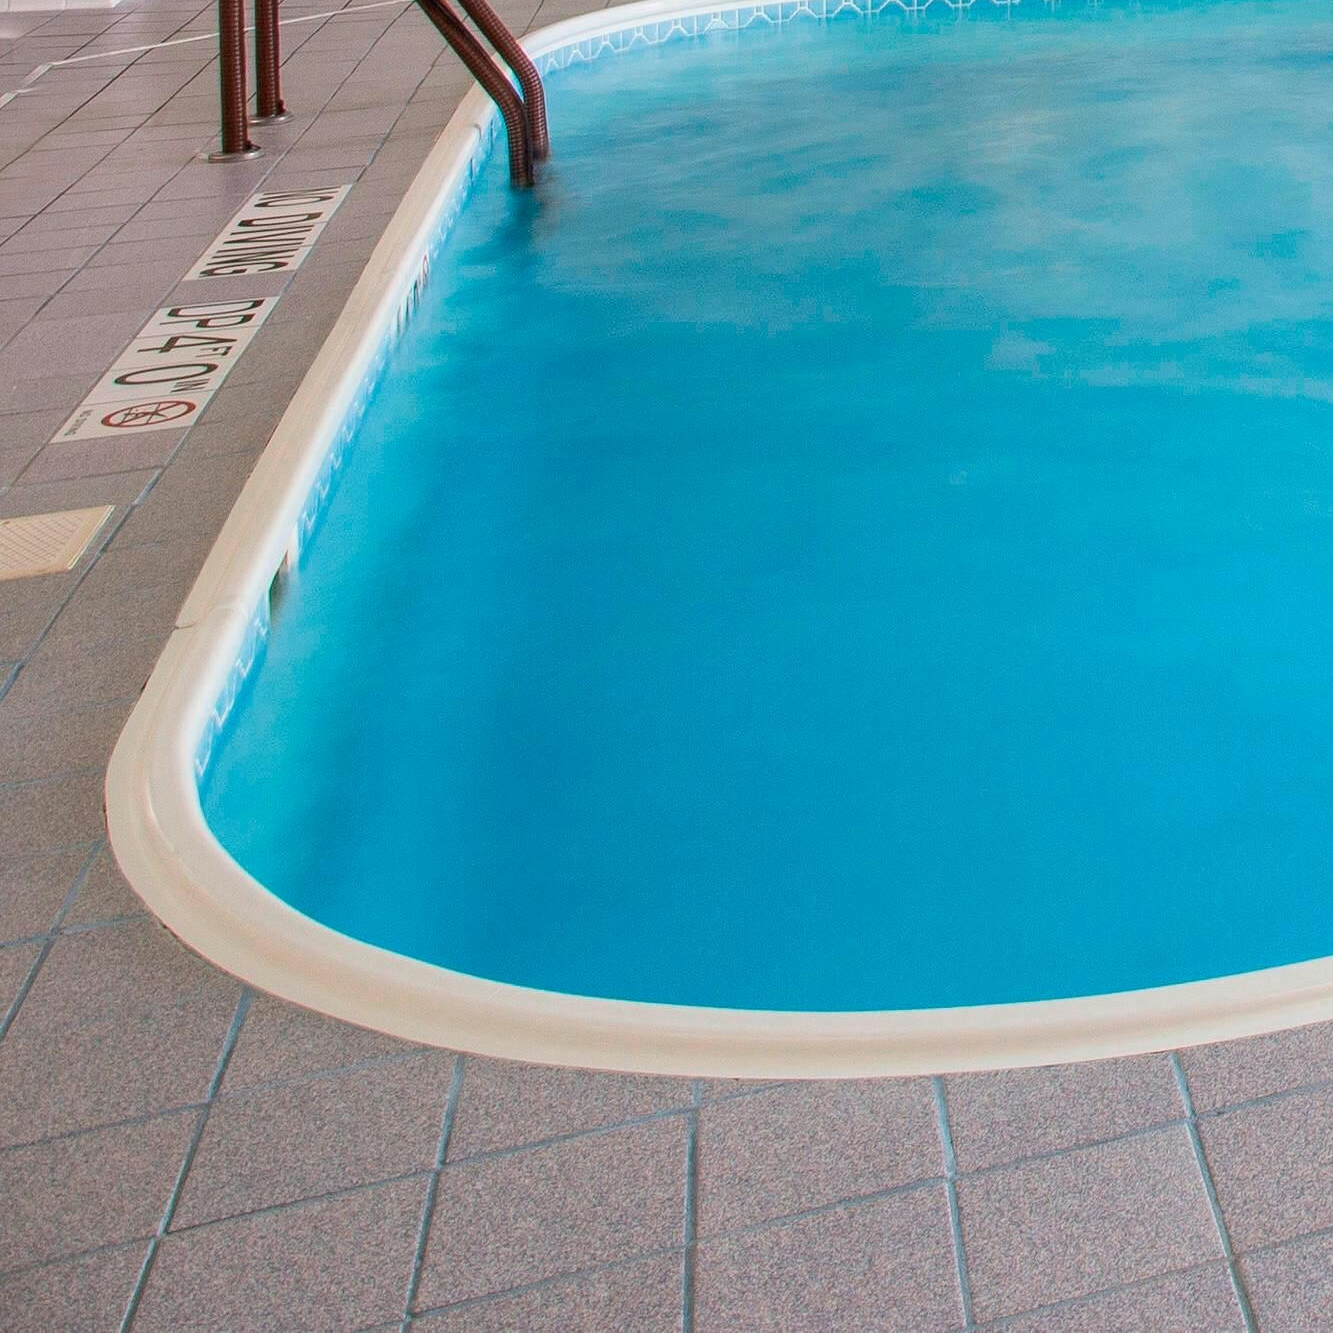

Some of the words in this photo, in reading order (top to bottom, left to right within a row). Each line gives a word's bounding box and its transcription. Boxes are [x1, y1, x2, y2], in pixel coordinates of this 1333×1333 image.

[254, 185, 342, 208] NO
[199, 212, 324, 278] DIVING
[159, 299, 265, 328] DP
